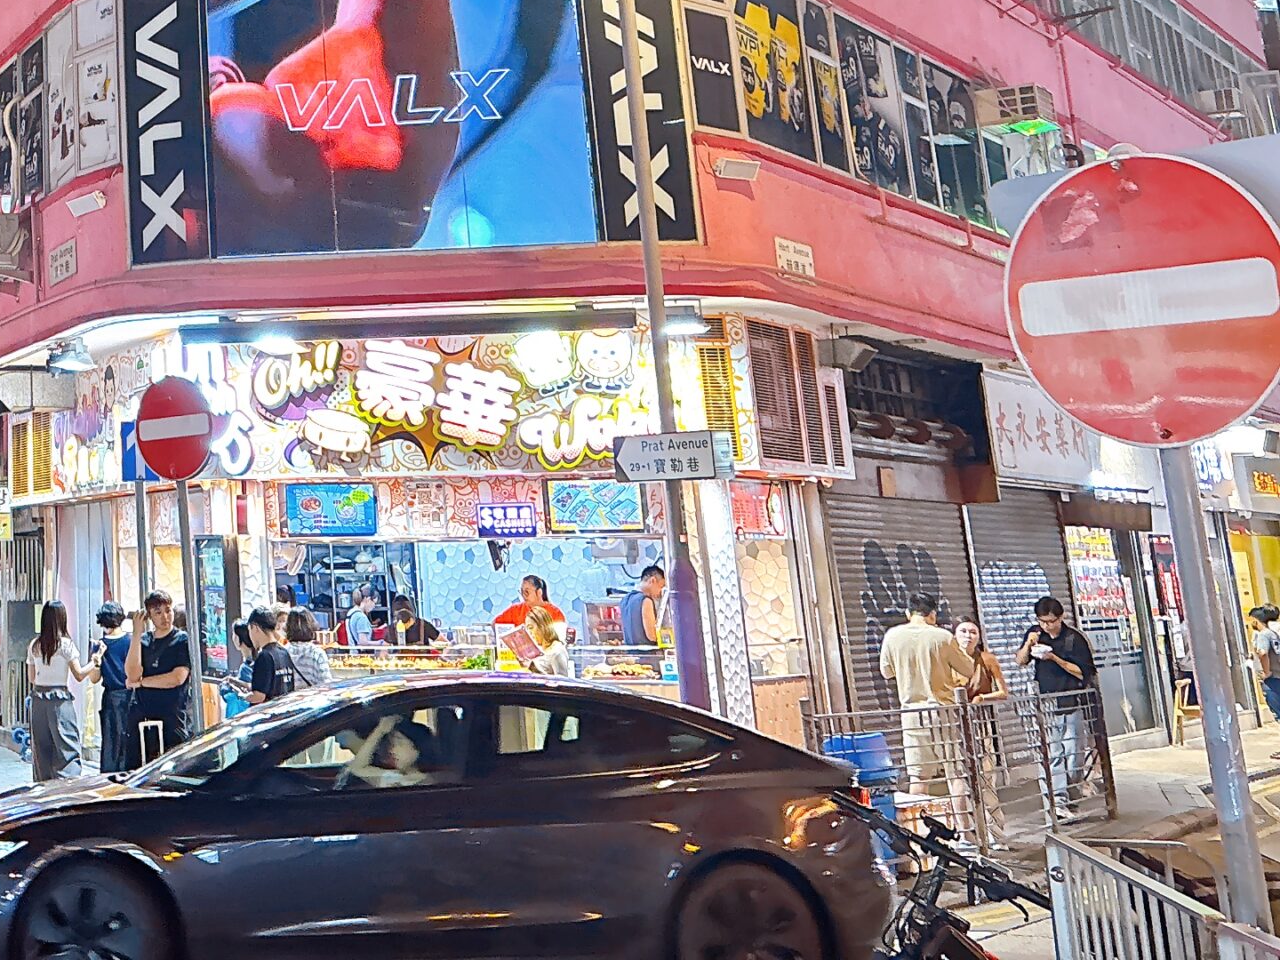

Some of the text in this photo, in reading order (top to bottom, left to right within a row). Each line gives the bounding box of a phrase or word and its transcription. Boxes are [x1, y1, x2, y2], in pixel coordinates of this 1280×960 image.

[691, 55, 732, 76] VALX
[275, 68, 511, 132] VALX
[136, 1, 187, 253] VALX
[254, 341, 342, 408] Oh!!
[641, 438, 708, 452] Prat Avenue
[654, 456, 699, 474] 寶勒巷
